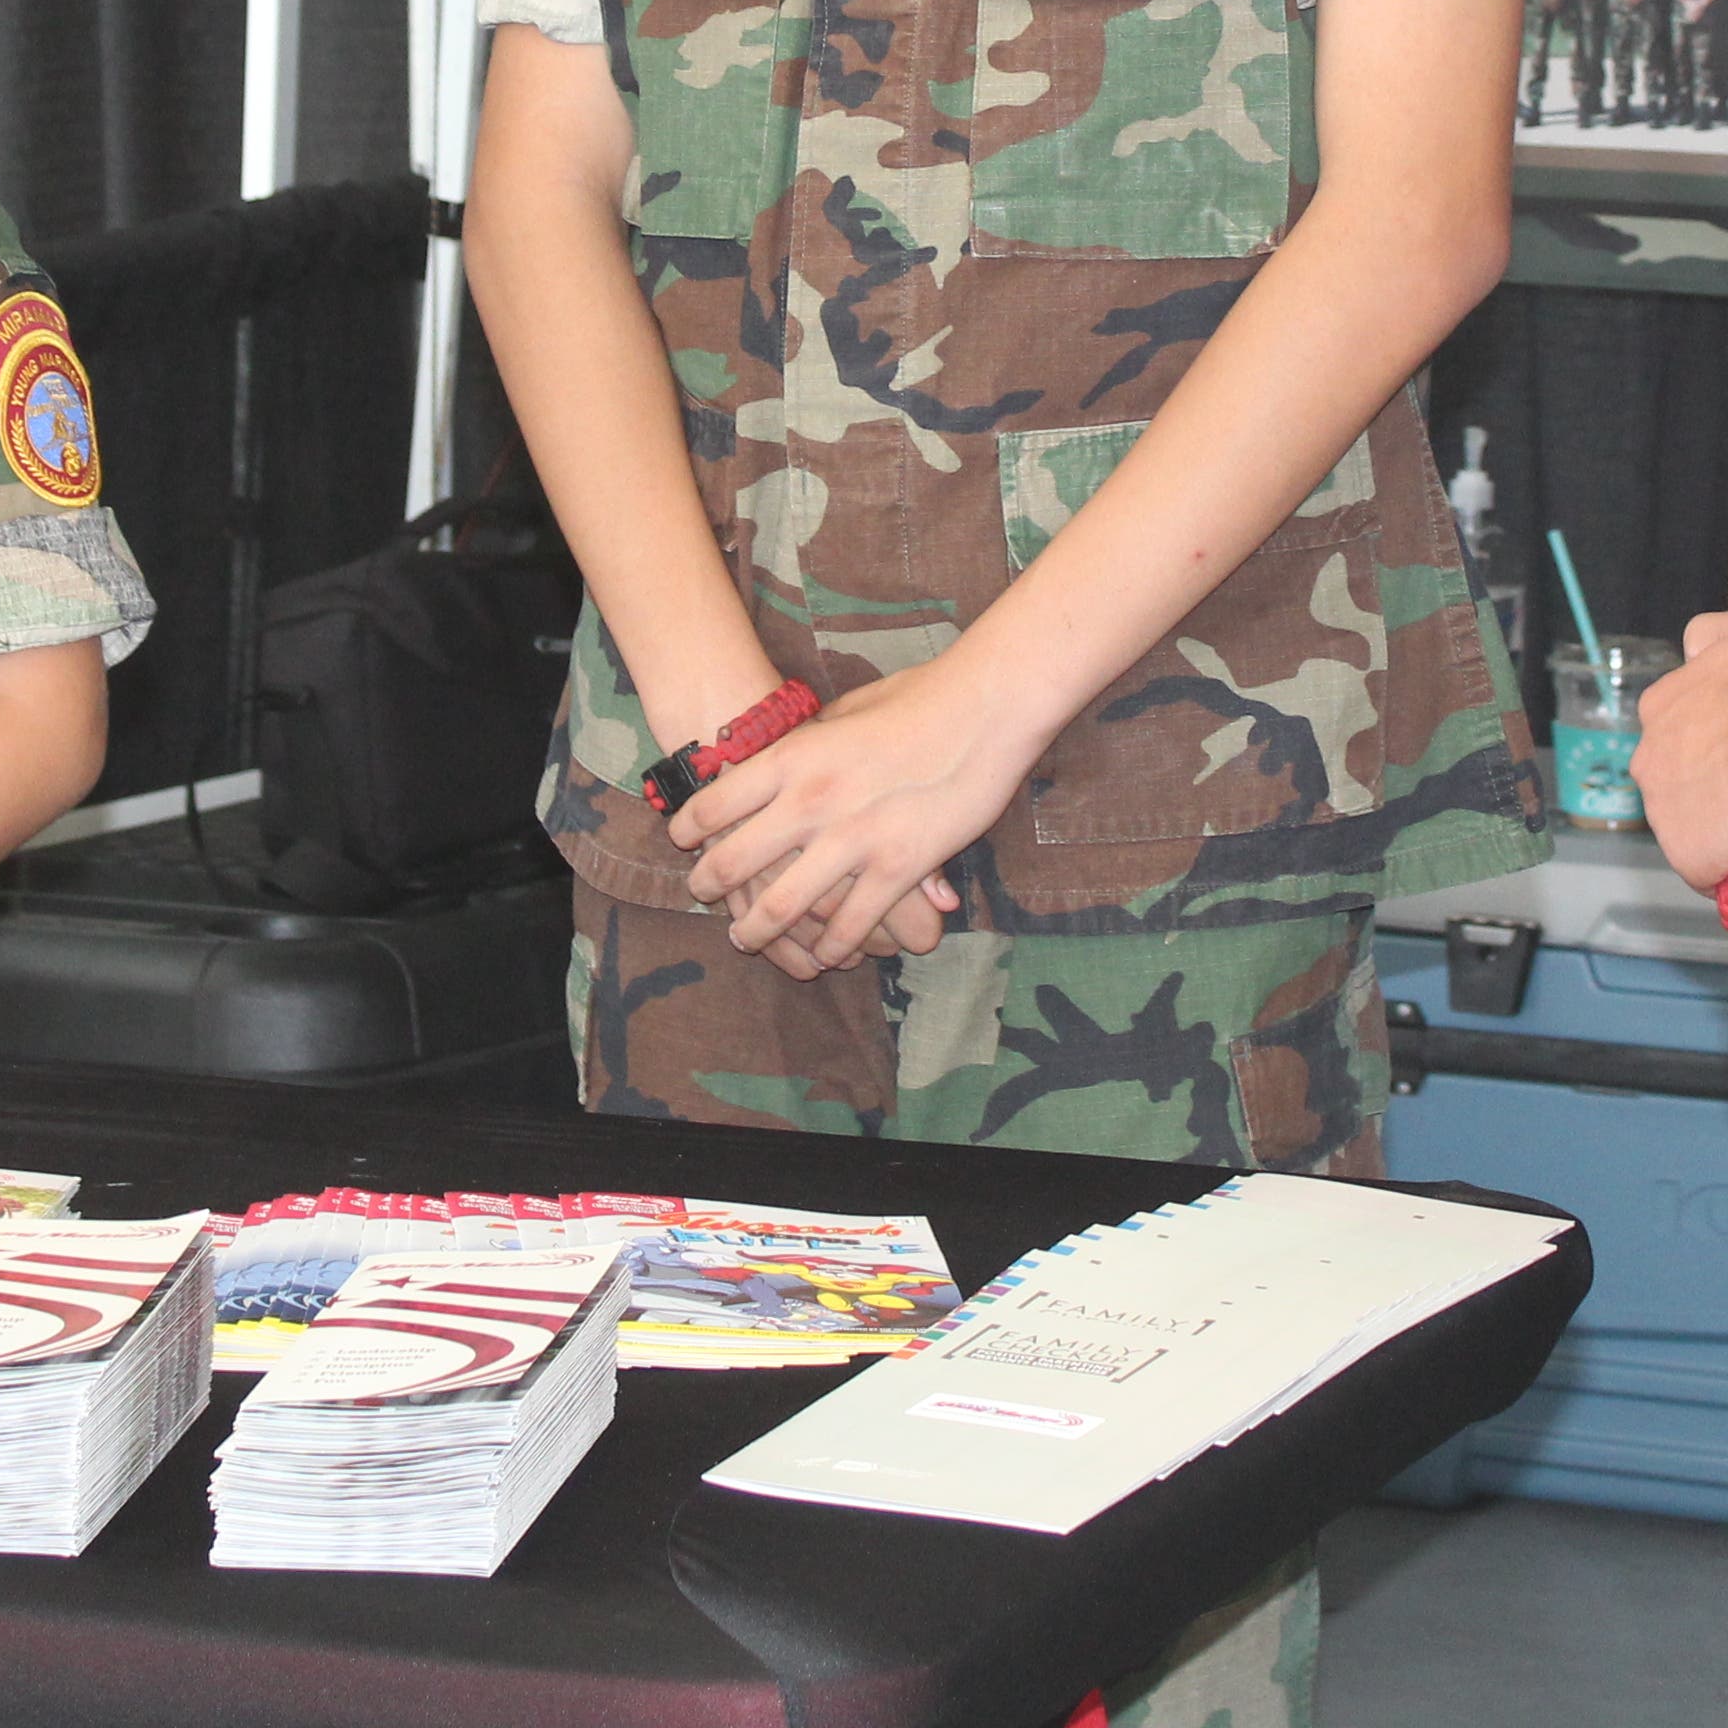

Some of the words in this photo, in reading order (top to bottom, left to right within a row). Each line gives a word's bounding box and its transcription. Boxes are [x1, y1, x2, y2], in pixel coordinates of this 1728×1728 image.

[10, 359, 40, 407] YOUNG
[1046, 1299, 1190, 1328] FAMILY
[987, 1339, 1131, 1366] CHECKUP
[998, 1329, 1143, 1357] FAMILY
